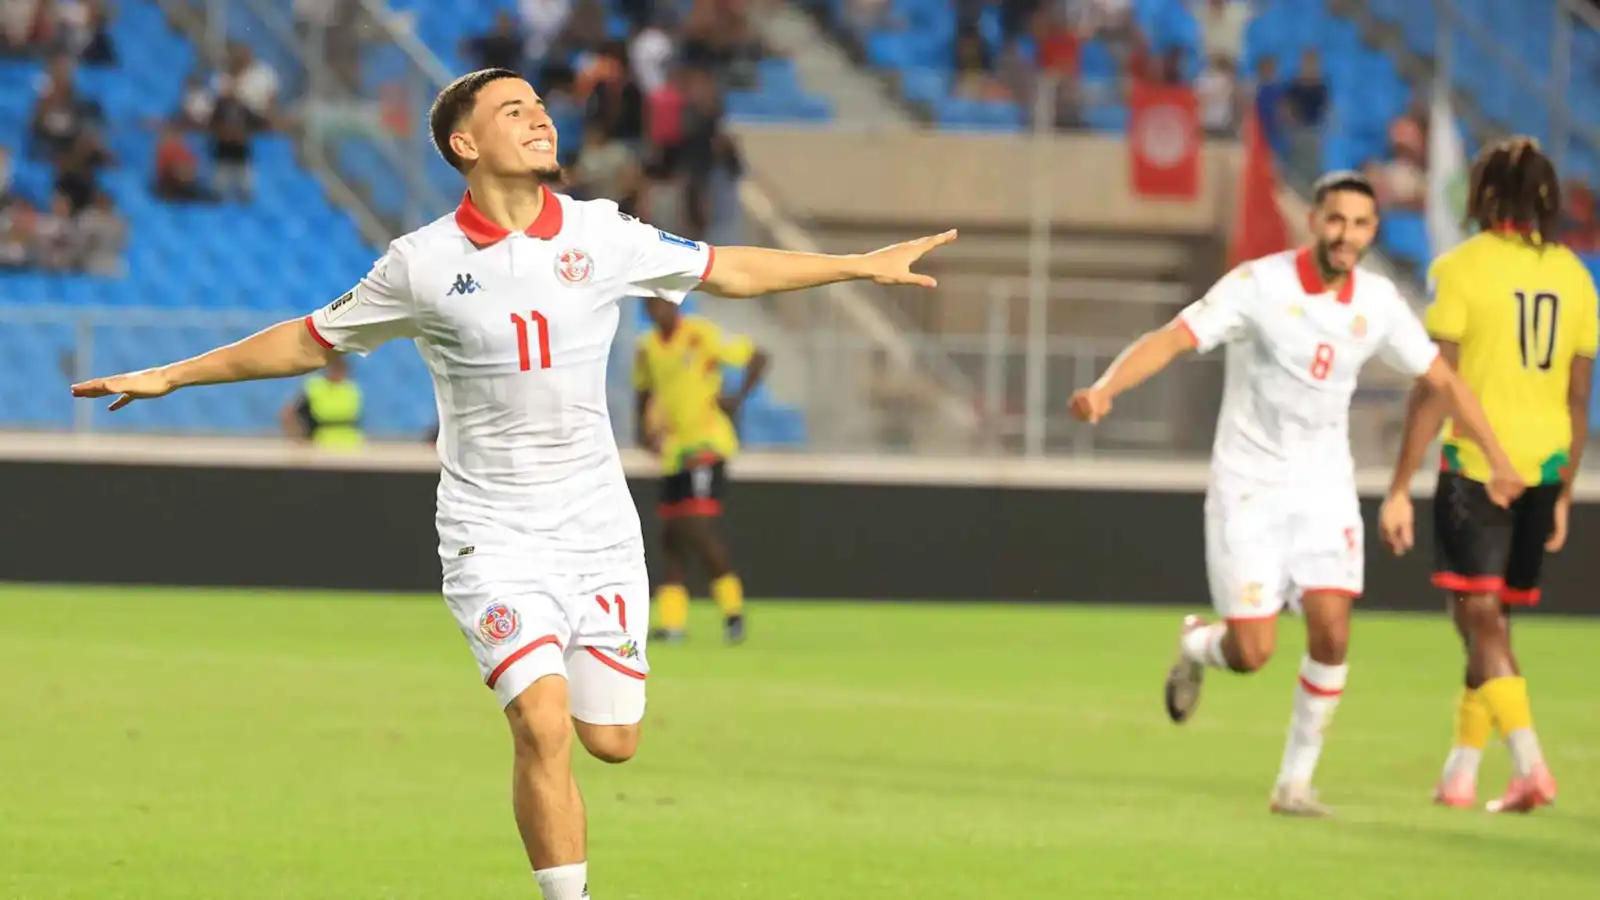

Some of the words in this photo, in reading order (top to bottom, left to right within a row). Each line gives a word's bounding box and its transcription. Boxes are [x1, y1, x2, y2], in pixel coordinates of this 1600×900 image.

[510, 310, 551, 372] 11
[1310, 344, 1334, 380] 8
[1513, 291, 1559, 371] 10
